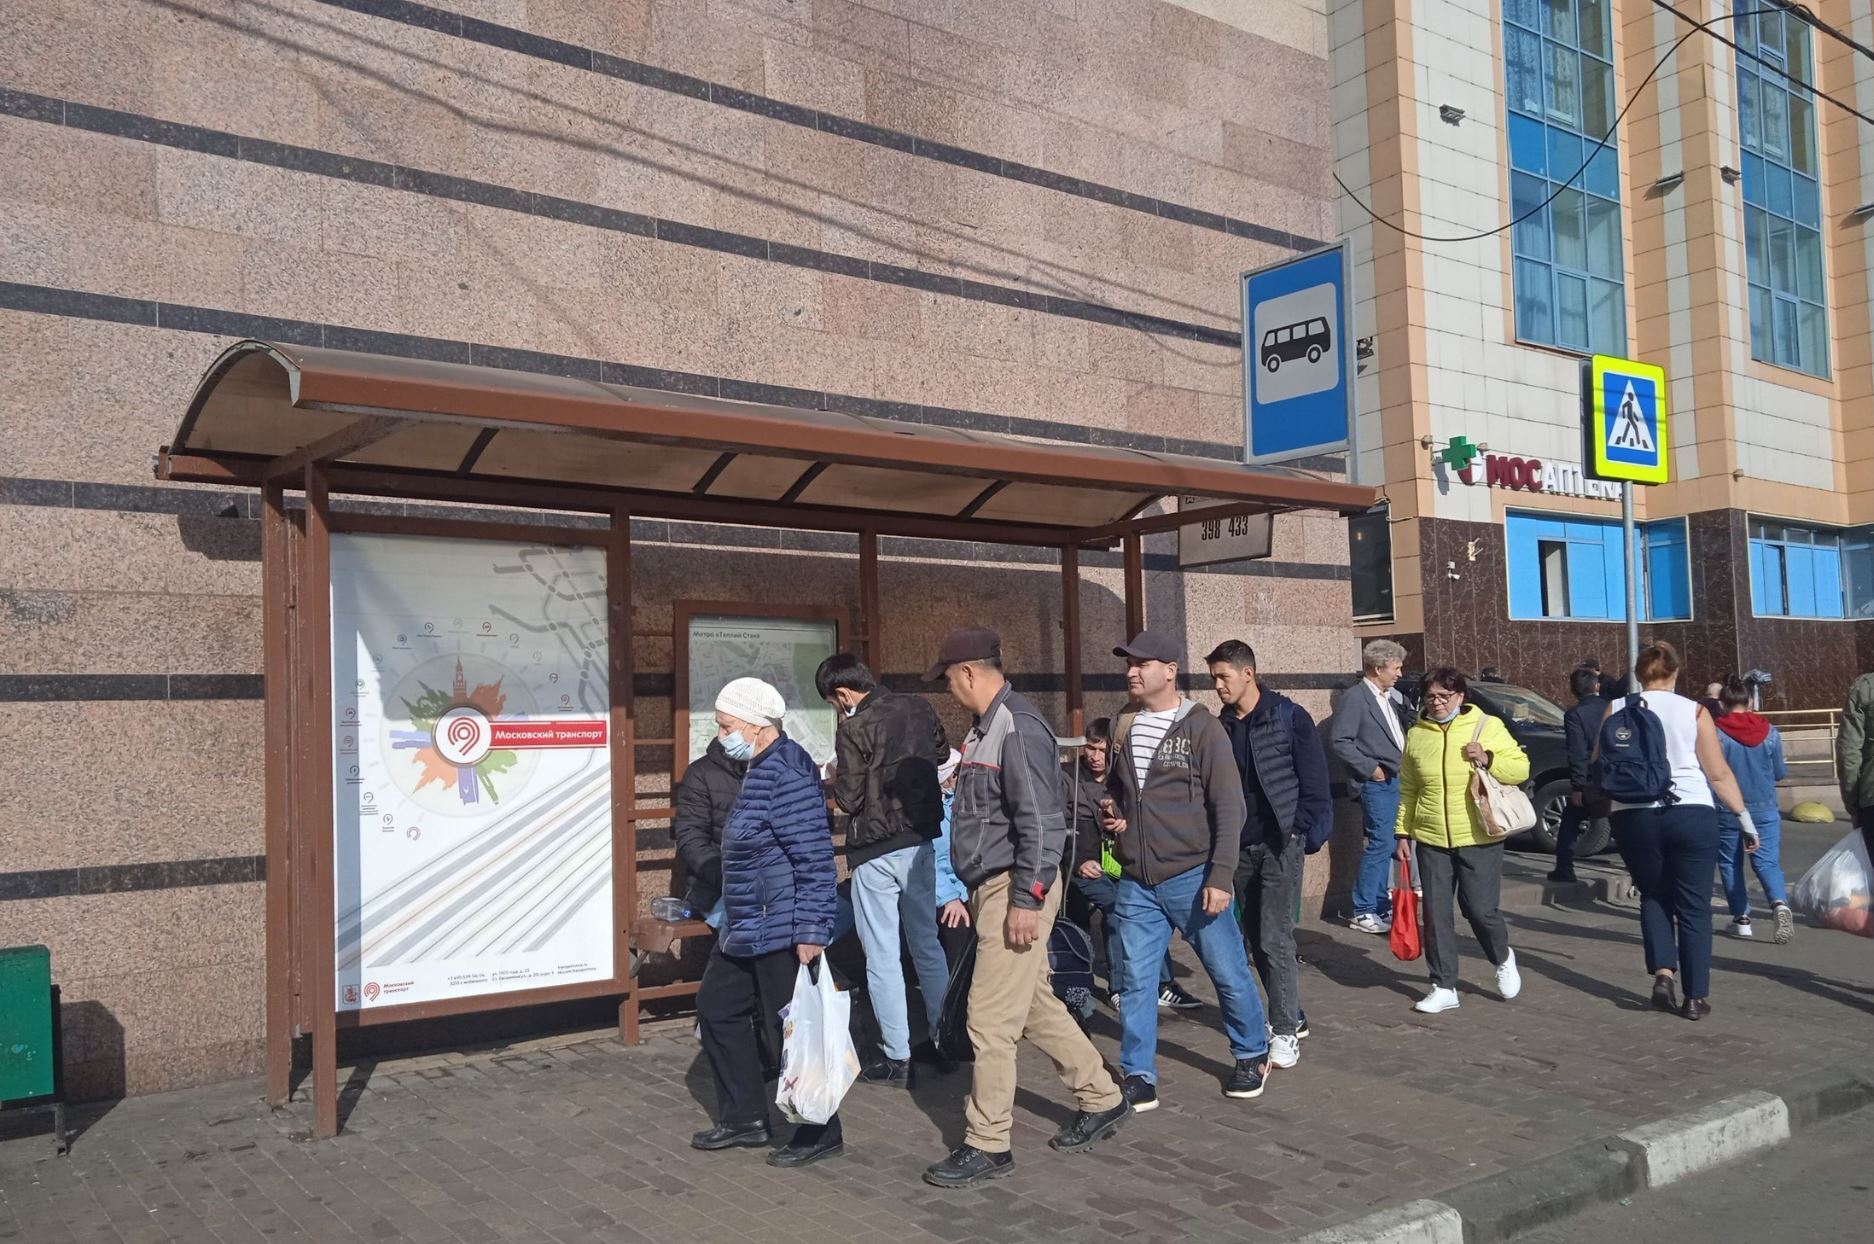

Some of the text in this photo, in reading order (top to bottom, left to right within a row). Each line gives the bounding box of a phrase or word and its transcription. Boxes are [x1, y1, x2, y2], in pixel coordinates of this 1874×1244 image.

[1486, 454, 1623, 500] МОСАПТЕК
[1201, 515, 1248, 541] 398 433
[495, 730, 603, 741] Московский транспорт
